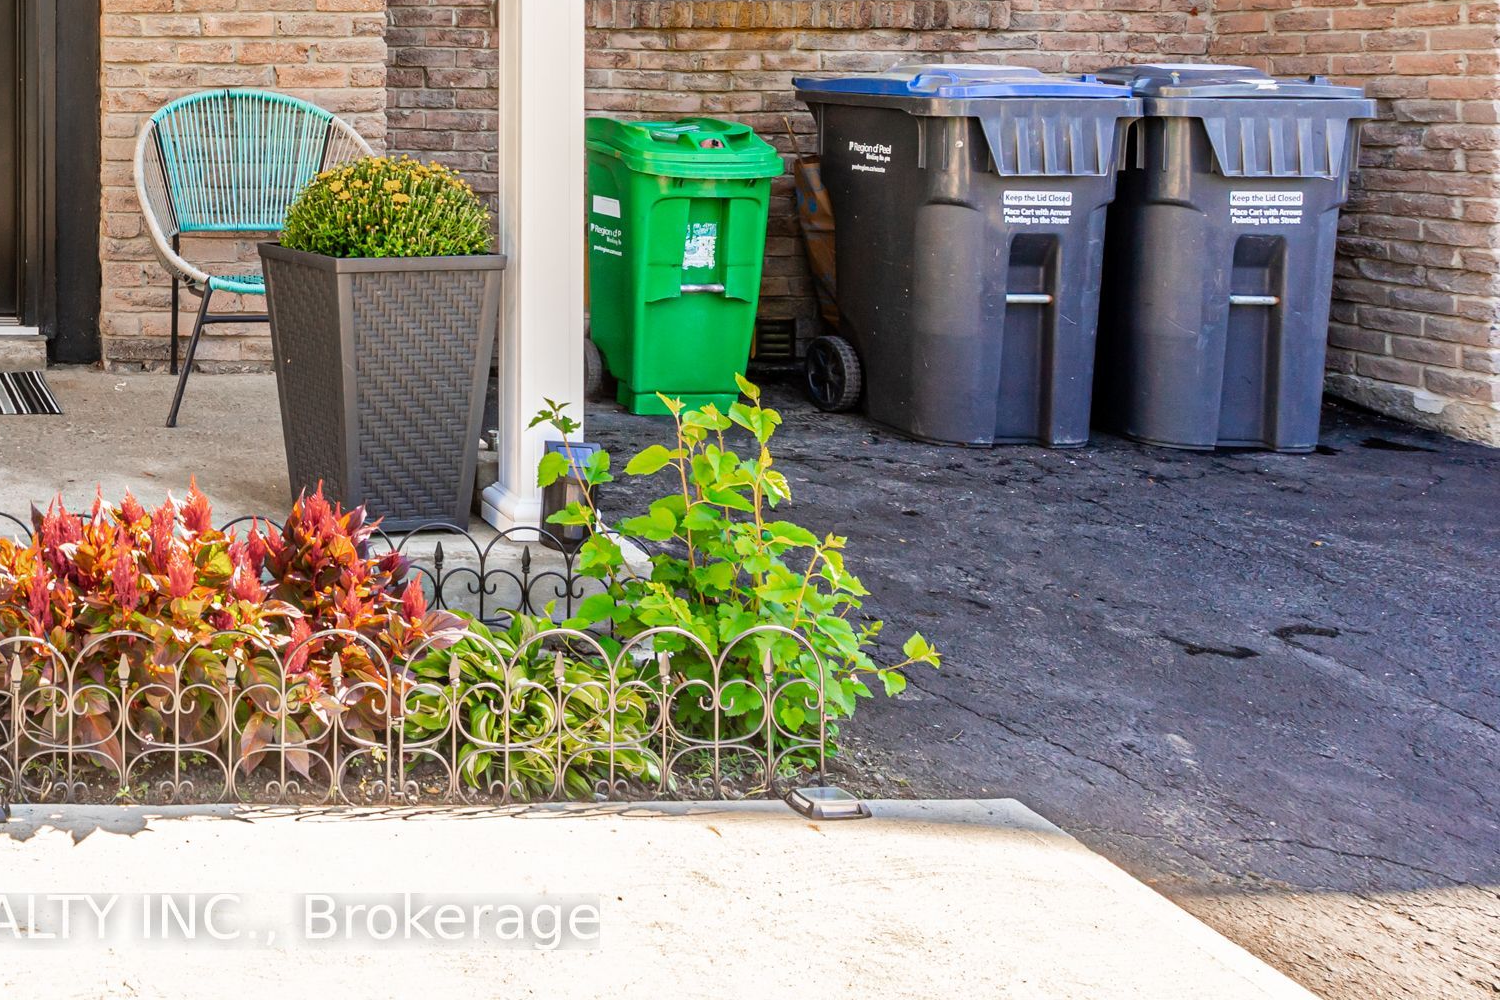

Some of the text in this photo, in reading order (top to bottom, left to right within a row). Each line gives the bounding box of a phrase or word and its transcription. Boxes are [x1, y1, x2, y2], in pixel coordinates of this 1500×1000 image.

[1005, 194, 1070, 203] Keep the Lid Closed
[1232, 194, 1301, 203] Keep the Lid Closed
[1035, 208, 1049, 216] with
[1230, 208, 1248, 216] Place
[1248, 208, 1263, 216] Cart
[1263, 208, 1279, 216] with
[1004, 216, 1031, 225] Pointing
[1040, 216, 1050, 224] the
[1231, 216, 1259, 225] Pointing
[1280, 216, 1301, 224] Street
